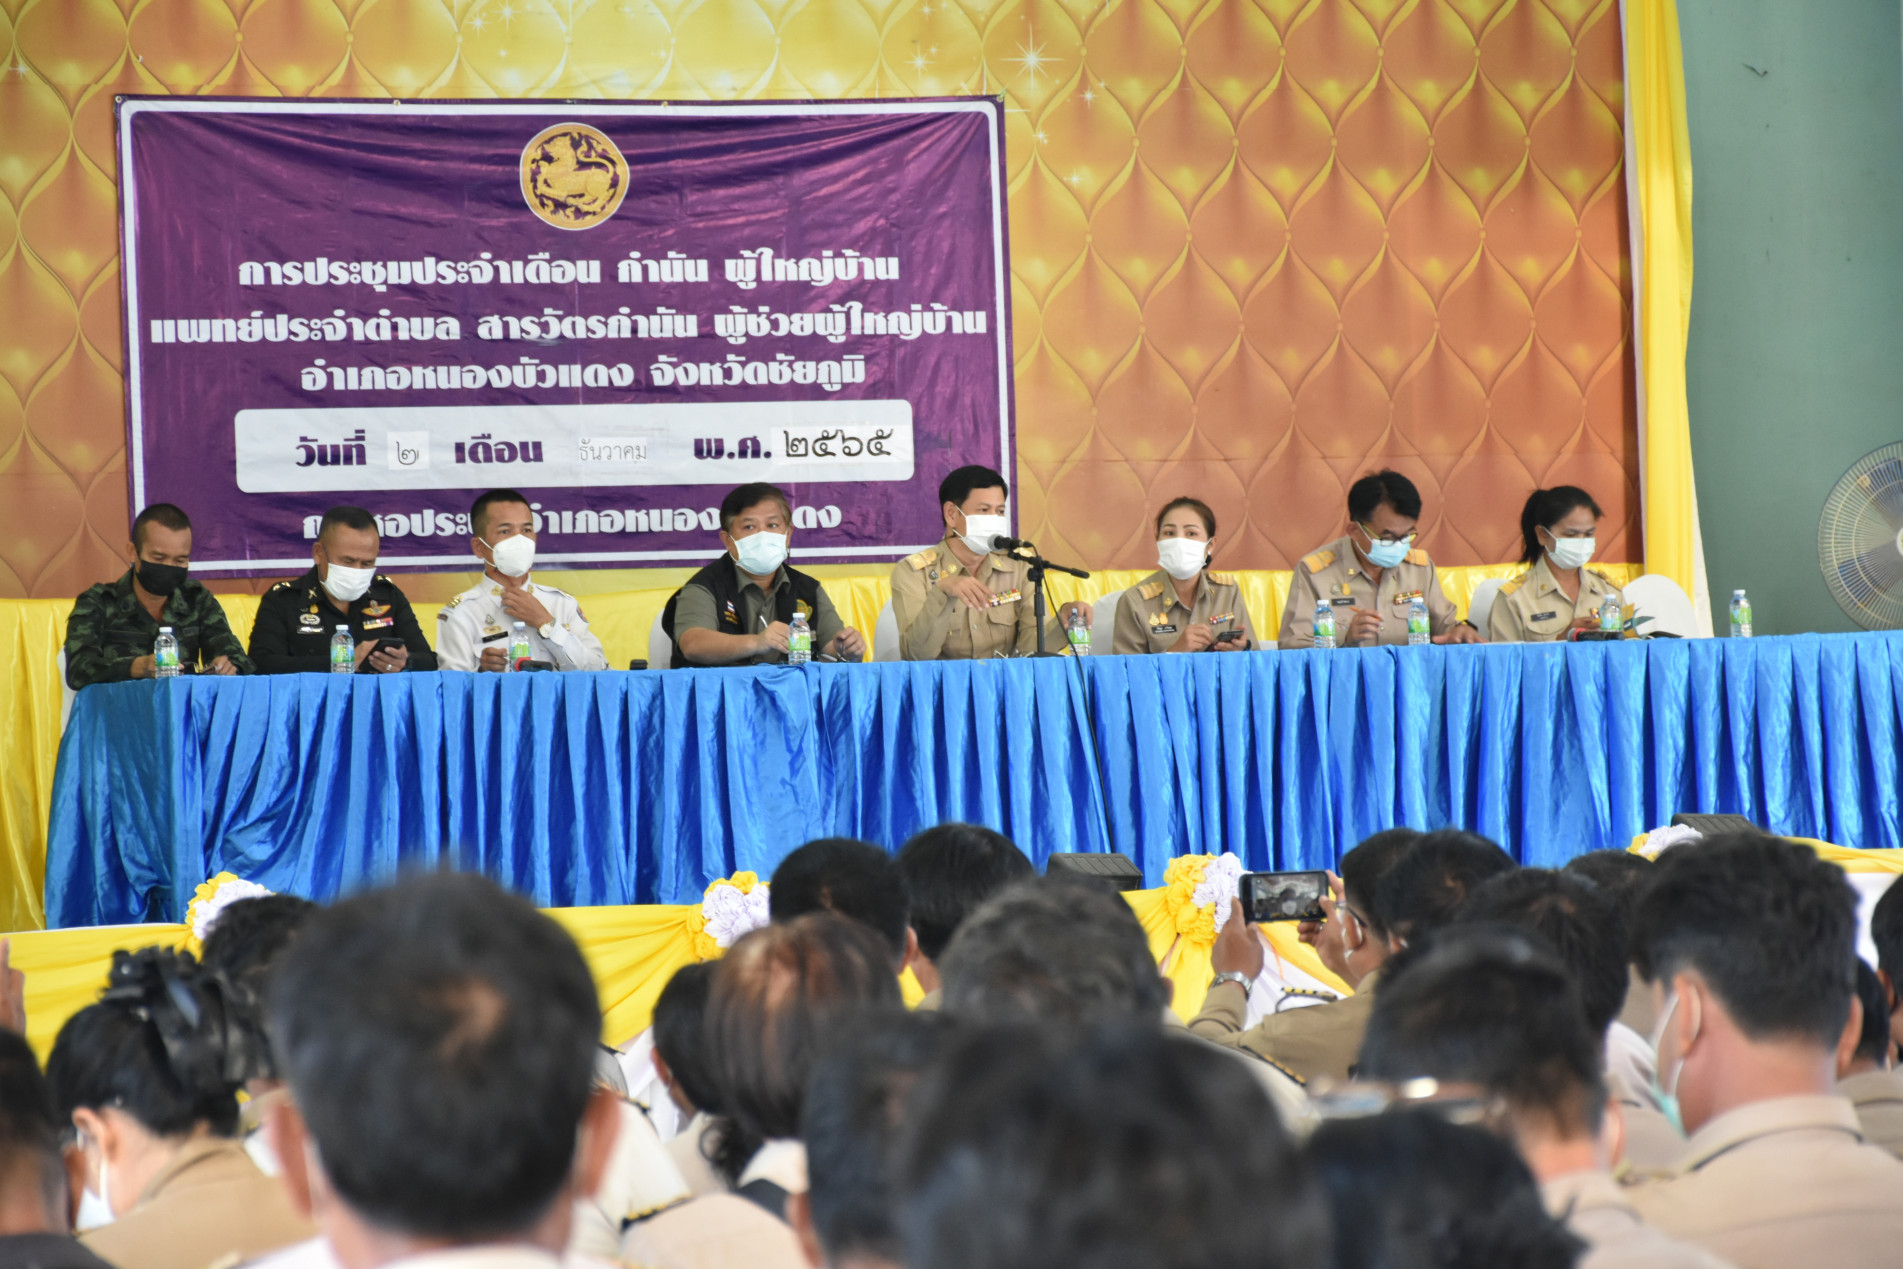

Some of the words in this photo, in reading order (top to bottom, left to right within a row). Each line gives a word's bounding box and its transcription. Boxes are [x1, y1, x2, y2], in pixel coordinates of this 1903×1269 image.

[239, 252, 600, 292] การประชุมประจำเดือน
[618, 251, 708, 282] กำนัน
[725, 247, 899, 289] ผู้ใหญ่บ้าน
[151, 309, 460, 342] แพทย์ประจำตำบล
[478, 307, 698, 340] สารวัตรกำนัน
[714, 301, 986, 344] ผู้ช่วยผู้ใหญ่บ้าน
[301, 357, 634, 390] อำเภอหนองบัวแดง
[650, 353, 865, 391] จังหวัดชัยภูมิ
[296, 430, 366, 466] วันที่
[396, 441, 418, 465] ๒
[455, 434, 543, 463] เดือน
[578, 437, 647, 462] ธันวาคม
[694, 436, 772, 459] พ.ศ.
[783, 428, 894, 458] ๒๕๖๕
